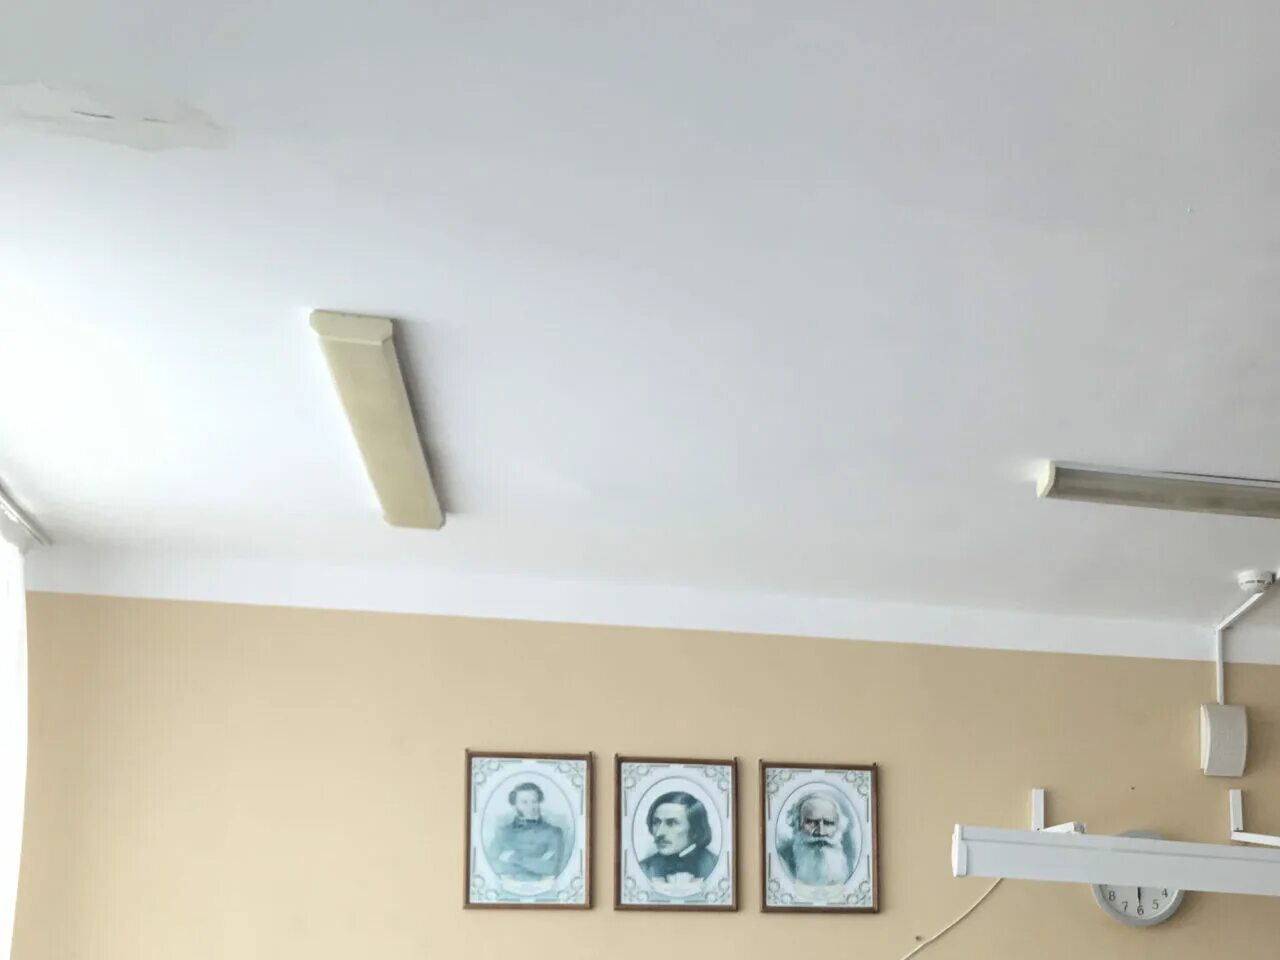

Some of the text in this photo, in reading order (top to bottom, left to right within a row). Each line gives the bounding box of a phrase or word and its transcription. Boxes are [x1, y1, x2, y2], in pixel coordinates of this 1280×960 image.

[1108, 890, 1116, 902] 8
[1161, 888, 1168, 898] 4
[1121, 901, 1129, 913] 7
[1136, 904, 1145, 916] 6
[1152, 899, 1160, 910] 5
